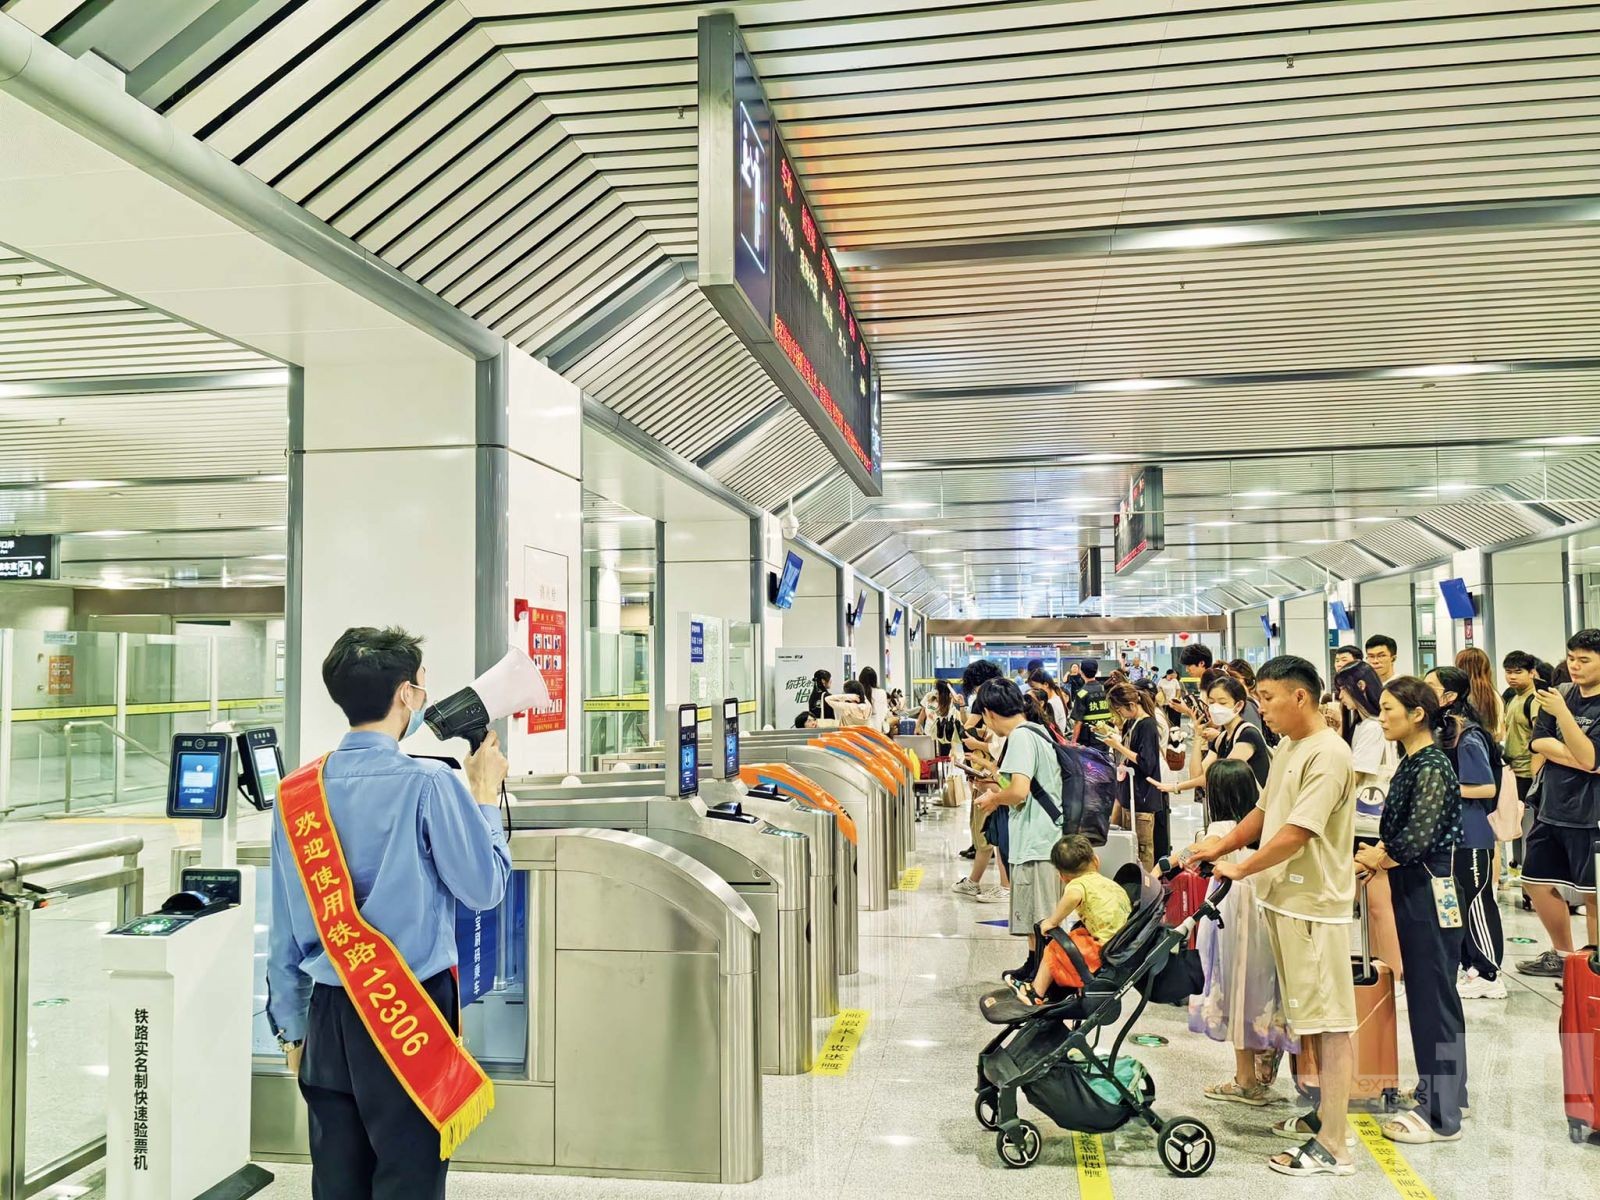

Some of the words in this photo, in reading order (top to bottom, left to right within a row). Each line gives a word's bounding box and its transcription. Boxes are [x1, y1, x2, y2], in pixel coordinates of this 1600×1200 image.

[295, 811, 429, 1057] 欢迎使用铁路12306
[134, 1008, 149, 1171] 铁路实名制快速验票机
